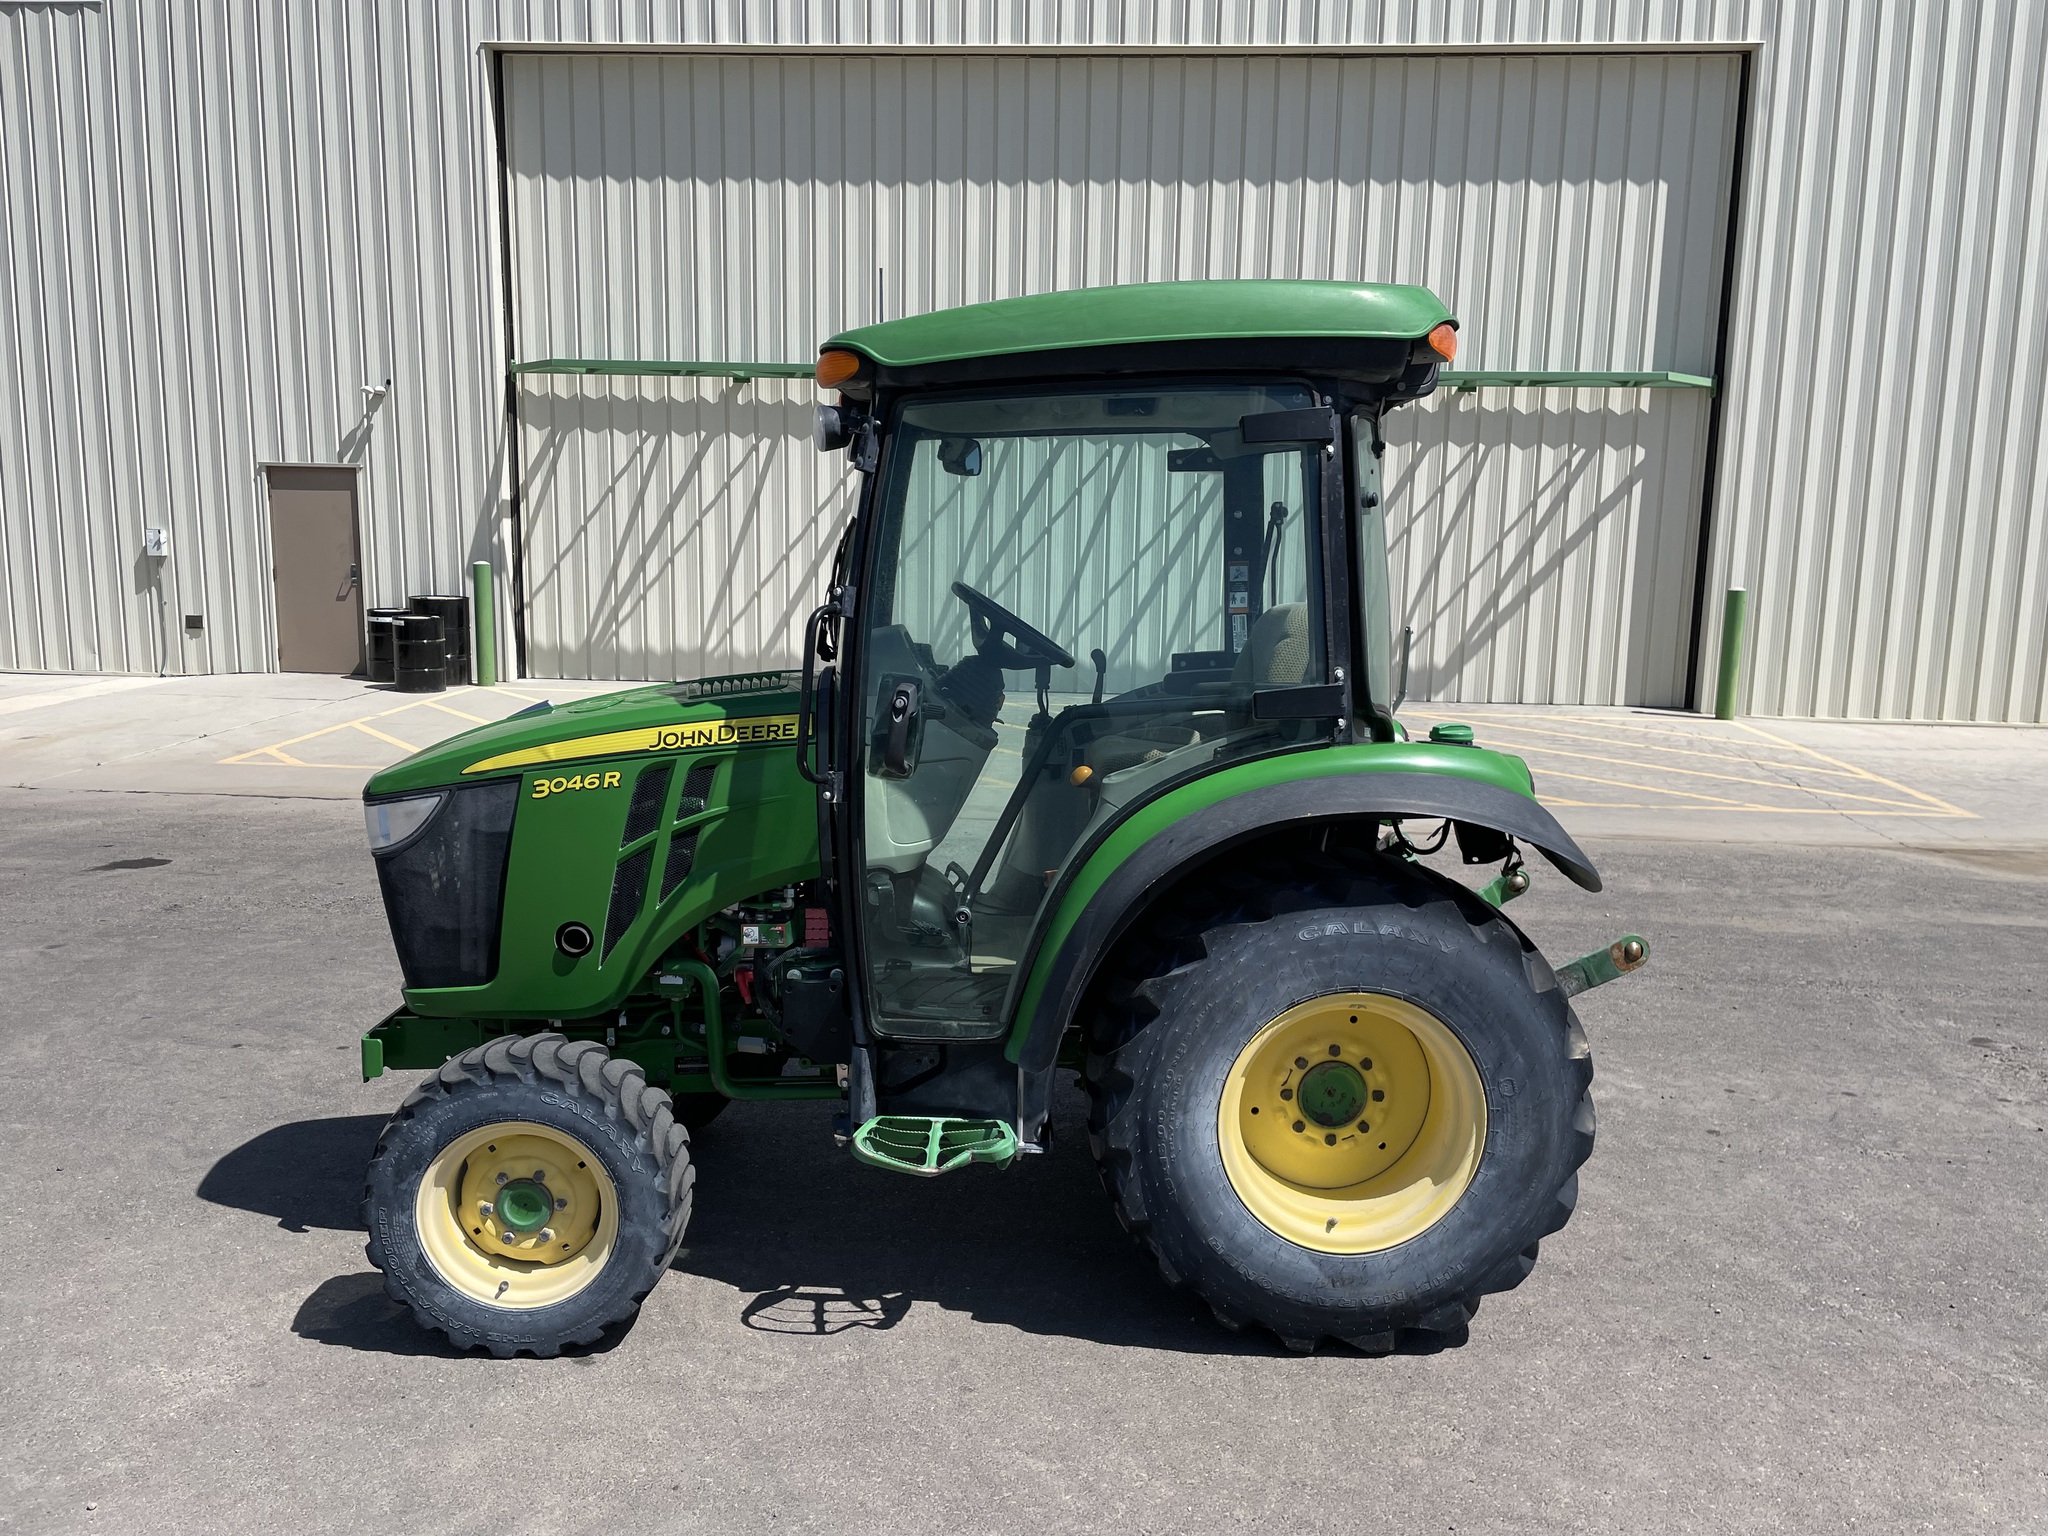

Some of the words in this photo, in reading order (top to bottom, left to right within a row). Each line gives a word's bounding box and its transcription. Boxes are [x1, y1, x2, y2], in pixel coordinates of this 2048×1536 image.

[648, 729, 713, 751] JOHN
[718, 722, 796, 744] DEERE
[532, 770, 622, 800] 3046R
[1298, 920, 1460, 955] GALAXY
[539, 1091, 648, 1175] GALAXY
[1203, 1232, 1407, 1310] MARATHONER
